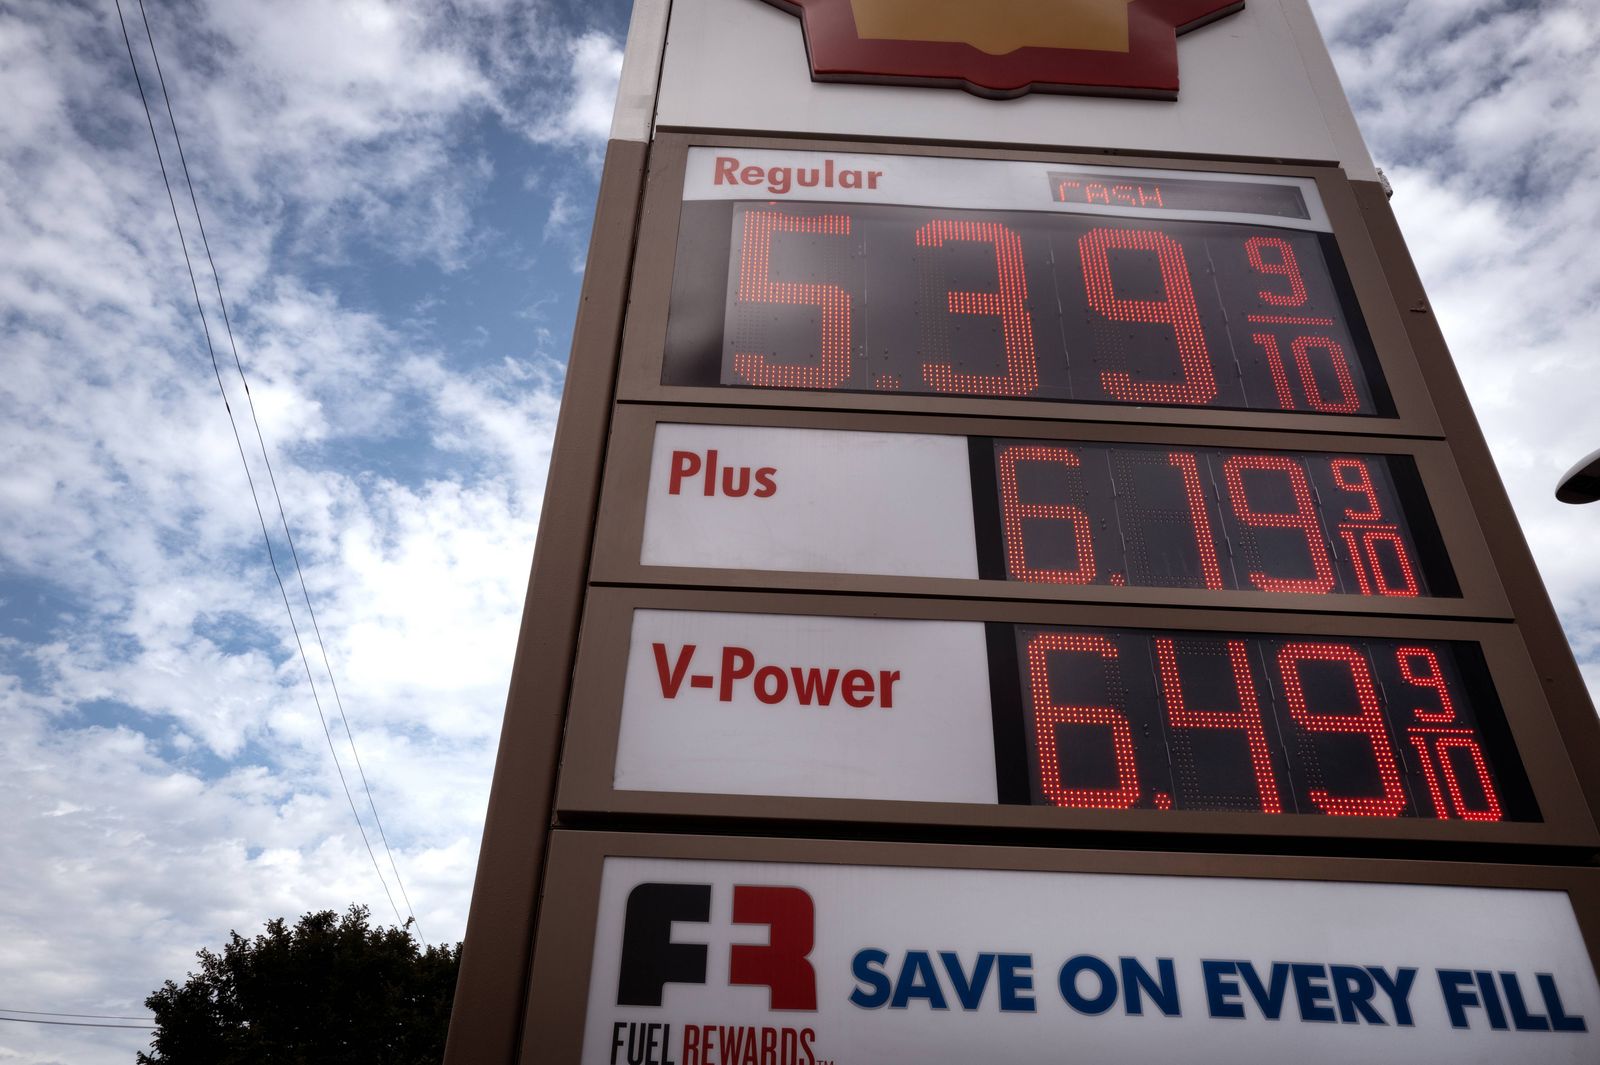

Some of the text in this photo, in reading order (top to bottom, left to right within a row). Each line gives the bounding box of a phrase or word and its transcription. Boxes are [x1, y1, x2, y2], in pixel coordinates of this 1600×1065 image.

[714, 156, 882, 193] Regular
[733, 208, 1218, 405] 5.39
[668, 449, 778, 498] Plus
[998, 445, 1336, 596] 6.19
[652, 642, 901, 709] V-Power
[1026, 633, 1406, 818] 6.49
[848, 948, 1586, 1033] SAVE ON EVERY FILL
[610, 1022, 675, 1065] FUEL
[682, 1024, 815, 1065] REWARDS
